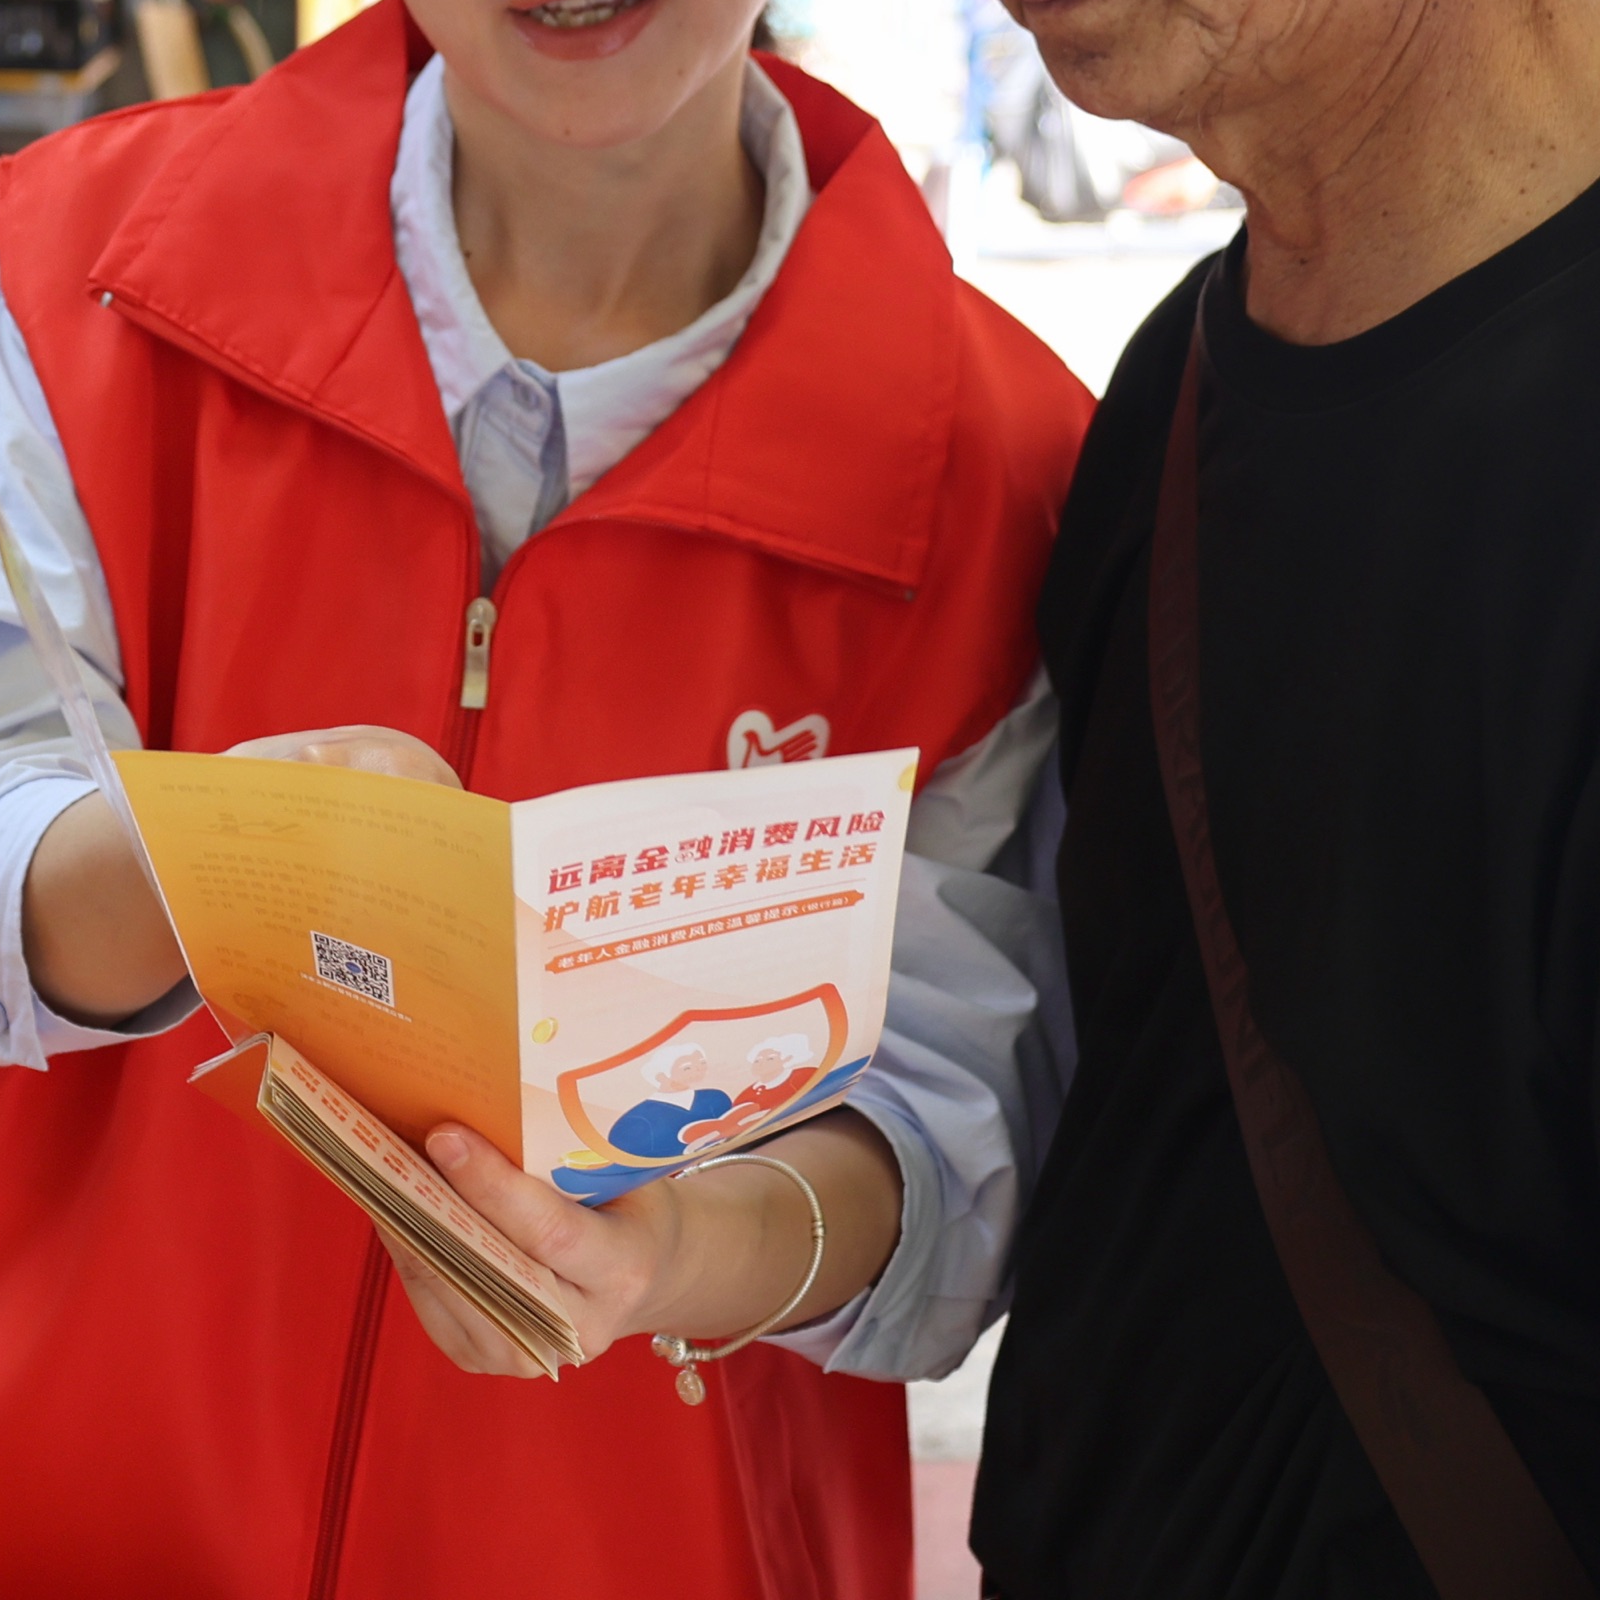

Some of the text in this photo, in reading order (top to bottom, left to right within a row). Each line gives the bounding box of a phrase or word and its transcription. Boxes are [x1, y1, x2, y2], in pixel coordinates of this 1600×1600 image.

[543, 842, 878, 933] 护航老年幸福生活
[547, 810, 886, 894] 远离金融消费风险
